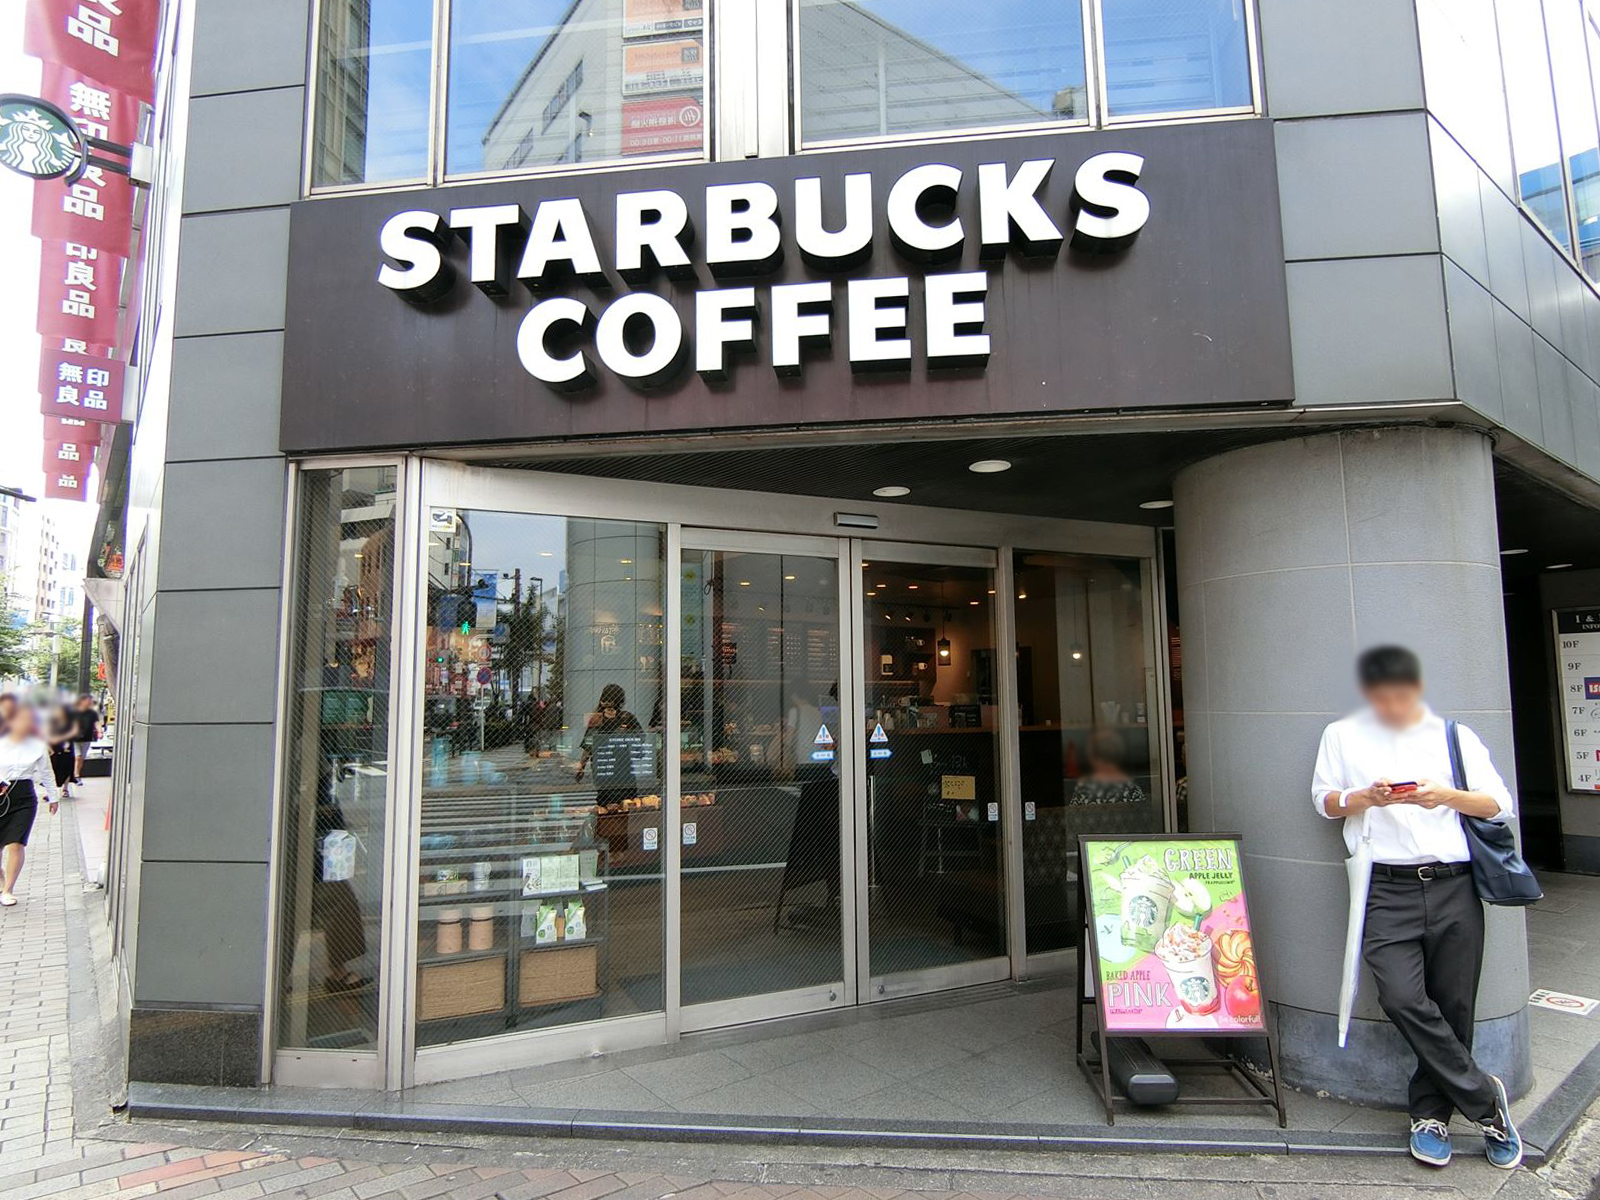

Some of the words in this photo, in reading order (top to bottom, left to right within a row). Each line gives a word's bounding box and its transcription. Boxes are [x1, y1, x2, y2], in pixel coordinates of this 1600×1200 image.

[376, 152, 1151, 291] STARBUCKS
[515, 271, 992, 384] COFFEE
[58, 362, 110, 387] 無印
[56, 385, 108, 411] 良品
[1163, 847, 1234, 872] GREEN
[1188, 872, 1210, 880] APPLE
[1106, 970, 1129, 981] BAKED
[1130, 970, 1151, 981] APPLE
[1106, 982, 1173, 1008] PINK
